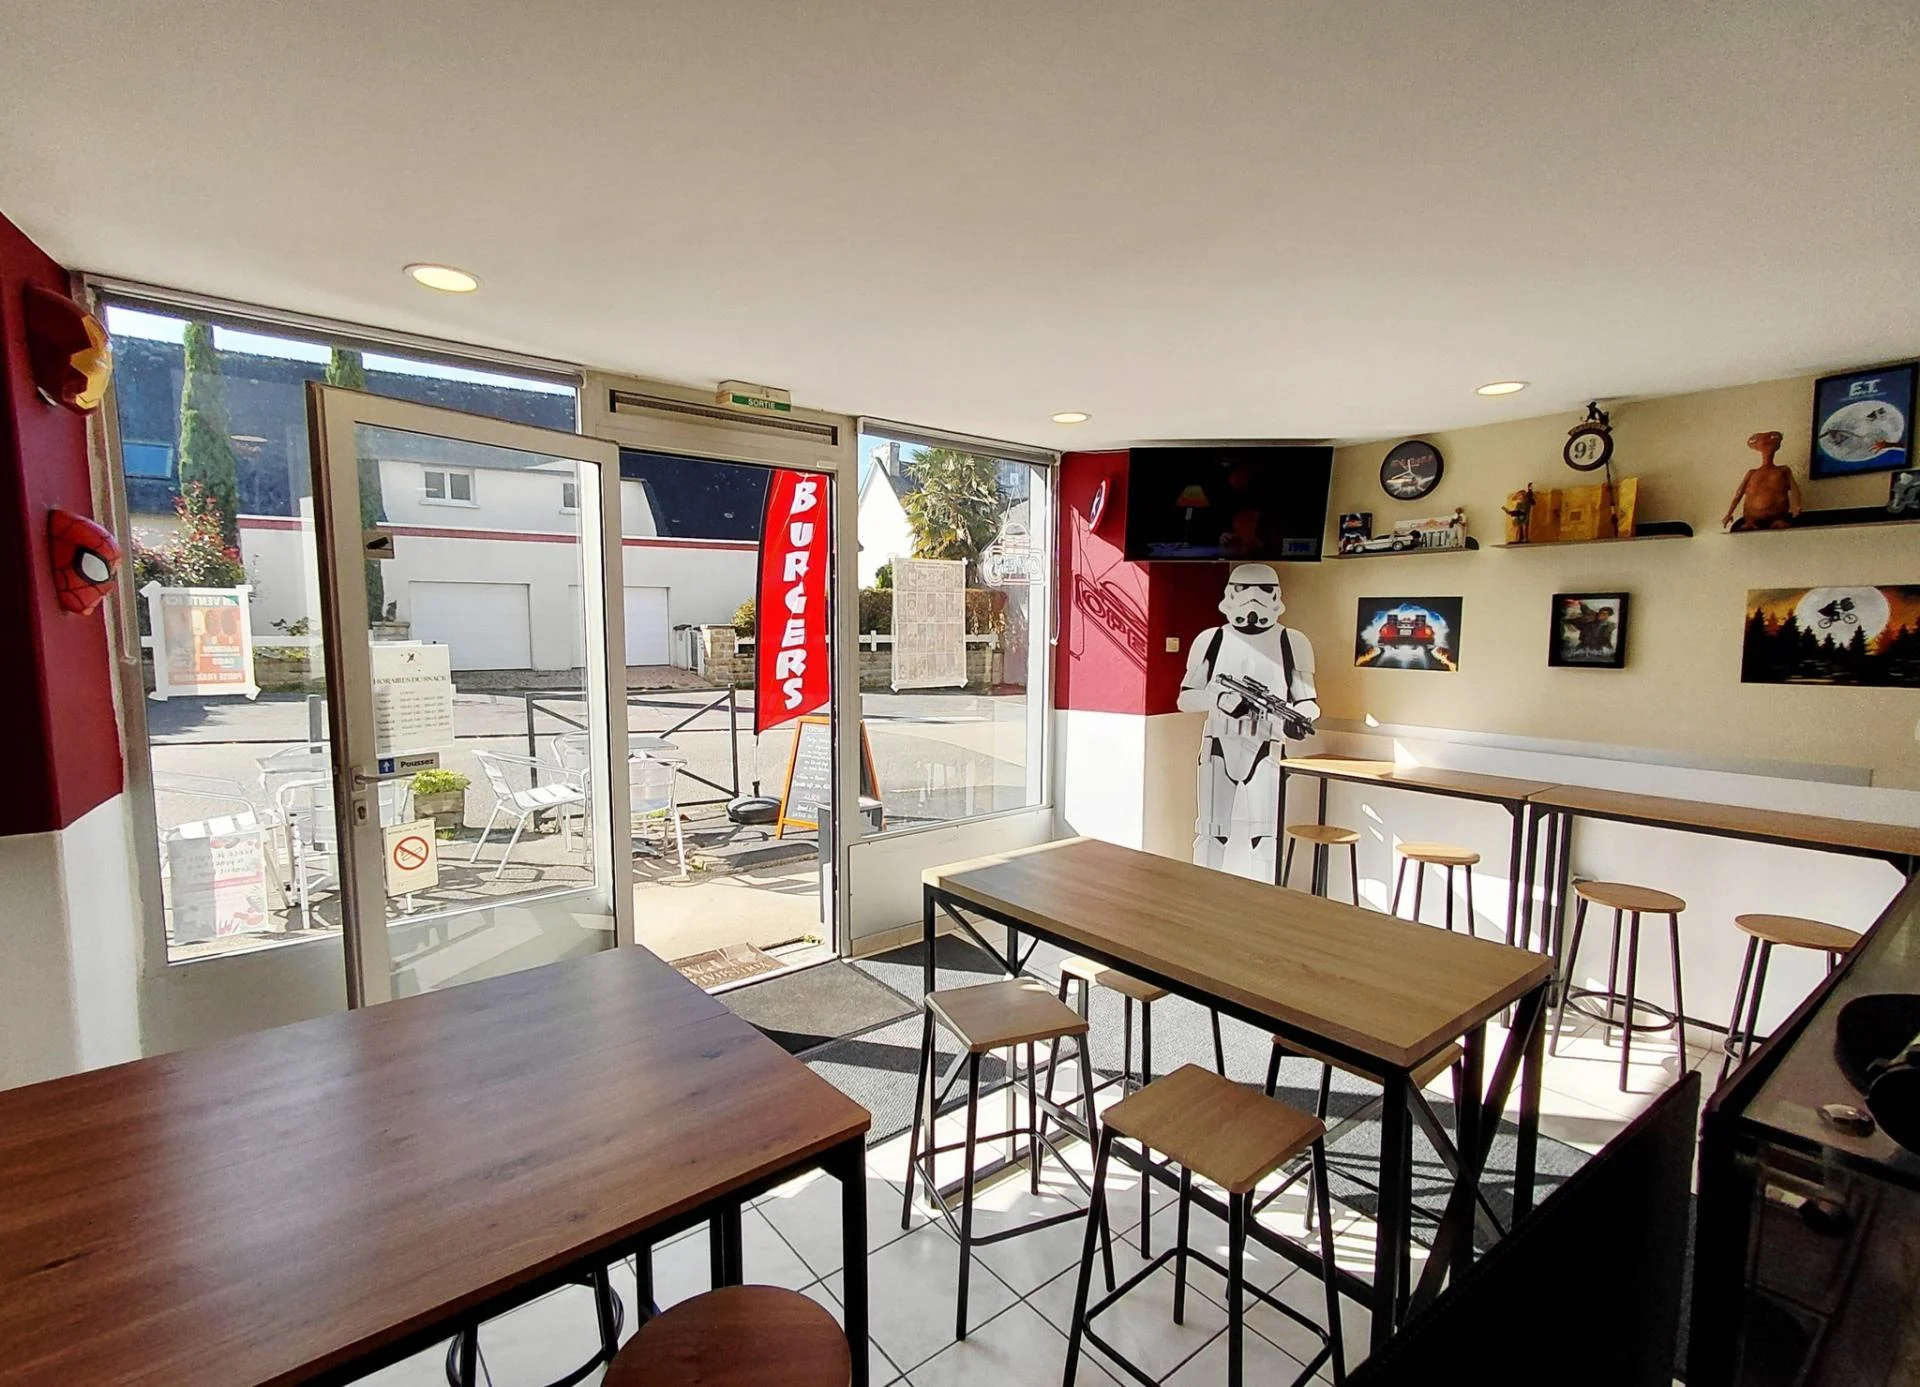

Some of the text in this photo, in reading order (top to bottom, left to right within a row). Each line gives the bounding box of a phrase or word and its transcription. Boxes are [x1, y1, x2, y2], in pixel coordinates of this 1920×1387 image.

[748, 398, 776, 410] SORTIE
[775, 481, 817, 710] BURGERS
[400, 759, 434, 768] Poussez
